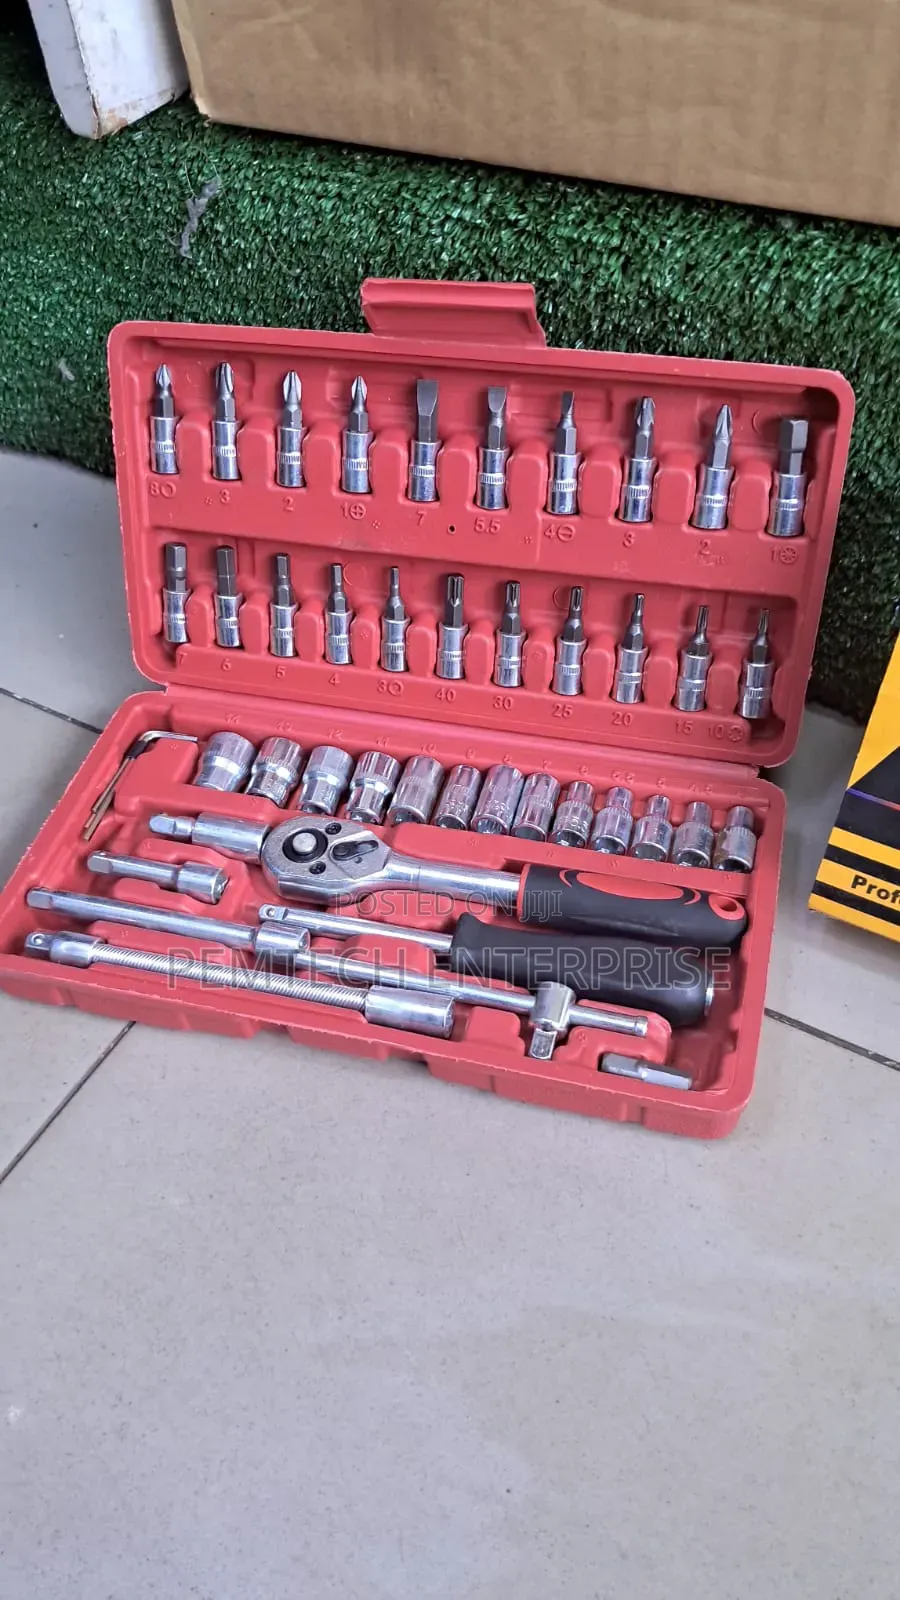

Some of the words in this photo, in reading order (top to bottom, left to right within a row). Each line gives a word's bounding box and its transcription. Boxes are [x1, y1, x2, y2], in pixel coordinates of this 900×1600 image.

[219, 489, 230, 504] 3
[282, 496, 294, 512] 2
[416, 510, 427, 527] 7
[474, 516, 501, 534] 5.5
[623, 531, 635, 549] 3
[699, 539, 711, 556] 2
[178, 651, 188, 665] 7
[220, 657, 231, 672] 6
[274, 664, 286, 680] 5
[328, 673, 340, 687] 4
[434, 687, 457, 703] 40
[492, 695, 514, 711] 30
[552, 703, 573, 720] 25
[610, 711, 633, 728] 20
[675, 719, 693, 736] 15
[850, 874, 900, 906] Prof
